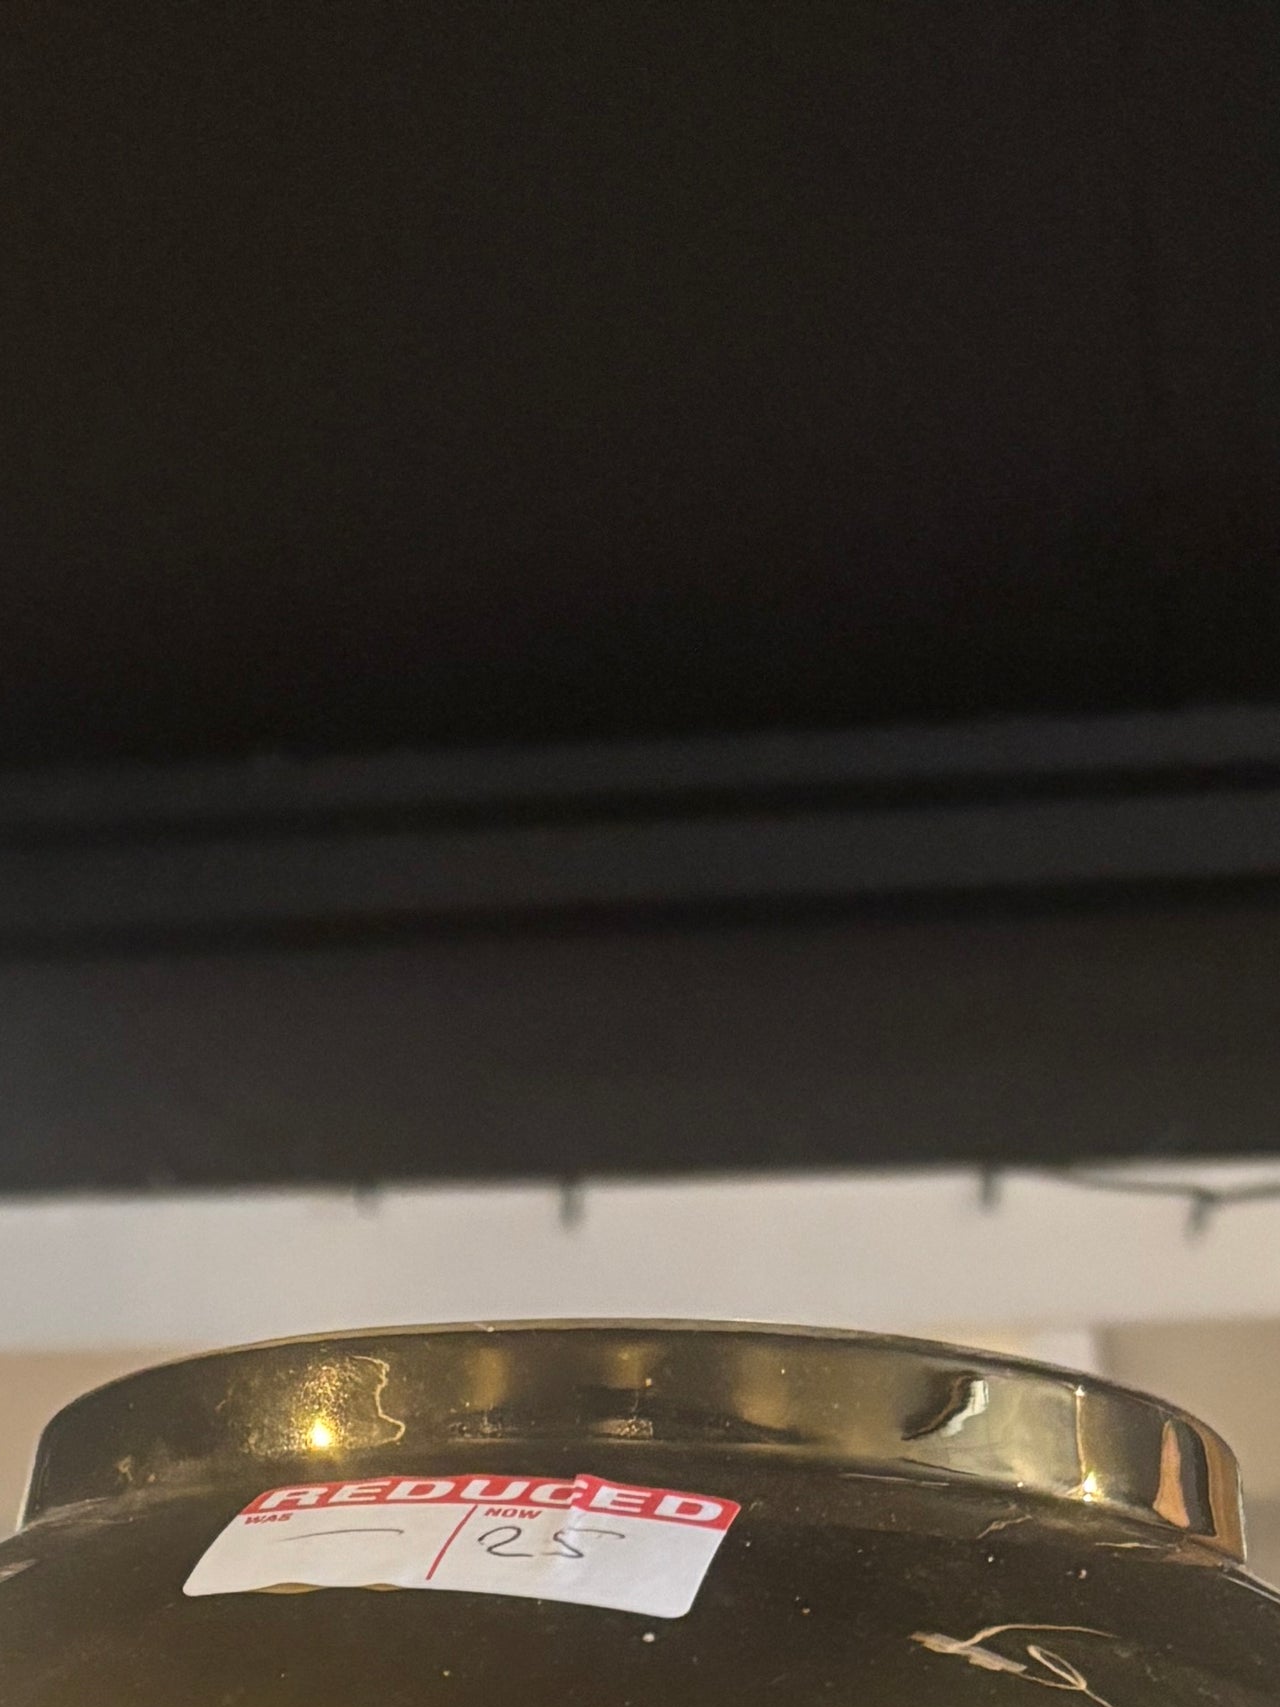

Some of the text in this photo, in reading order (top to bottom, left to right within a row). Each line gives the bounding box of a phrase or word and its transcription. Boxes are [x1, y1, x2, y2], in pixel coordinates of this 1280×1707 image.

[259, 1477, 724, 1522] REDUCED
[244, 1513, 291, 1525] WAS
[485, 1507, 541, 1520] NOW
[478, 1526, 626, 1559] 25
